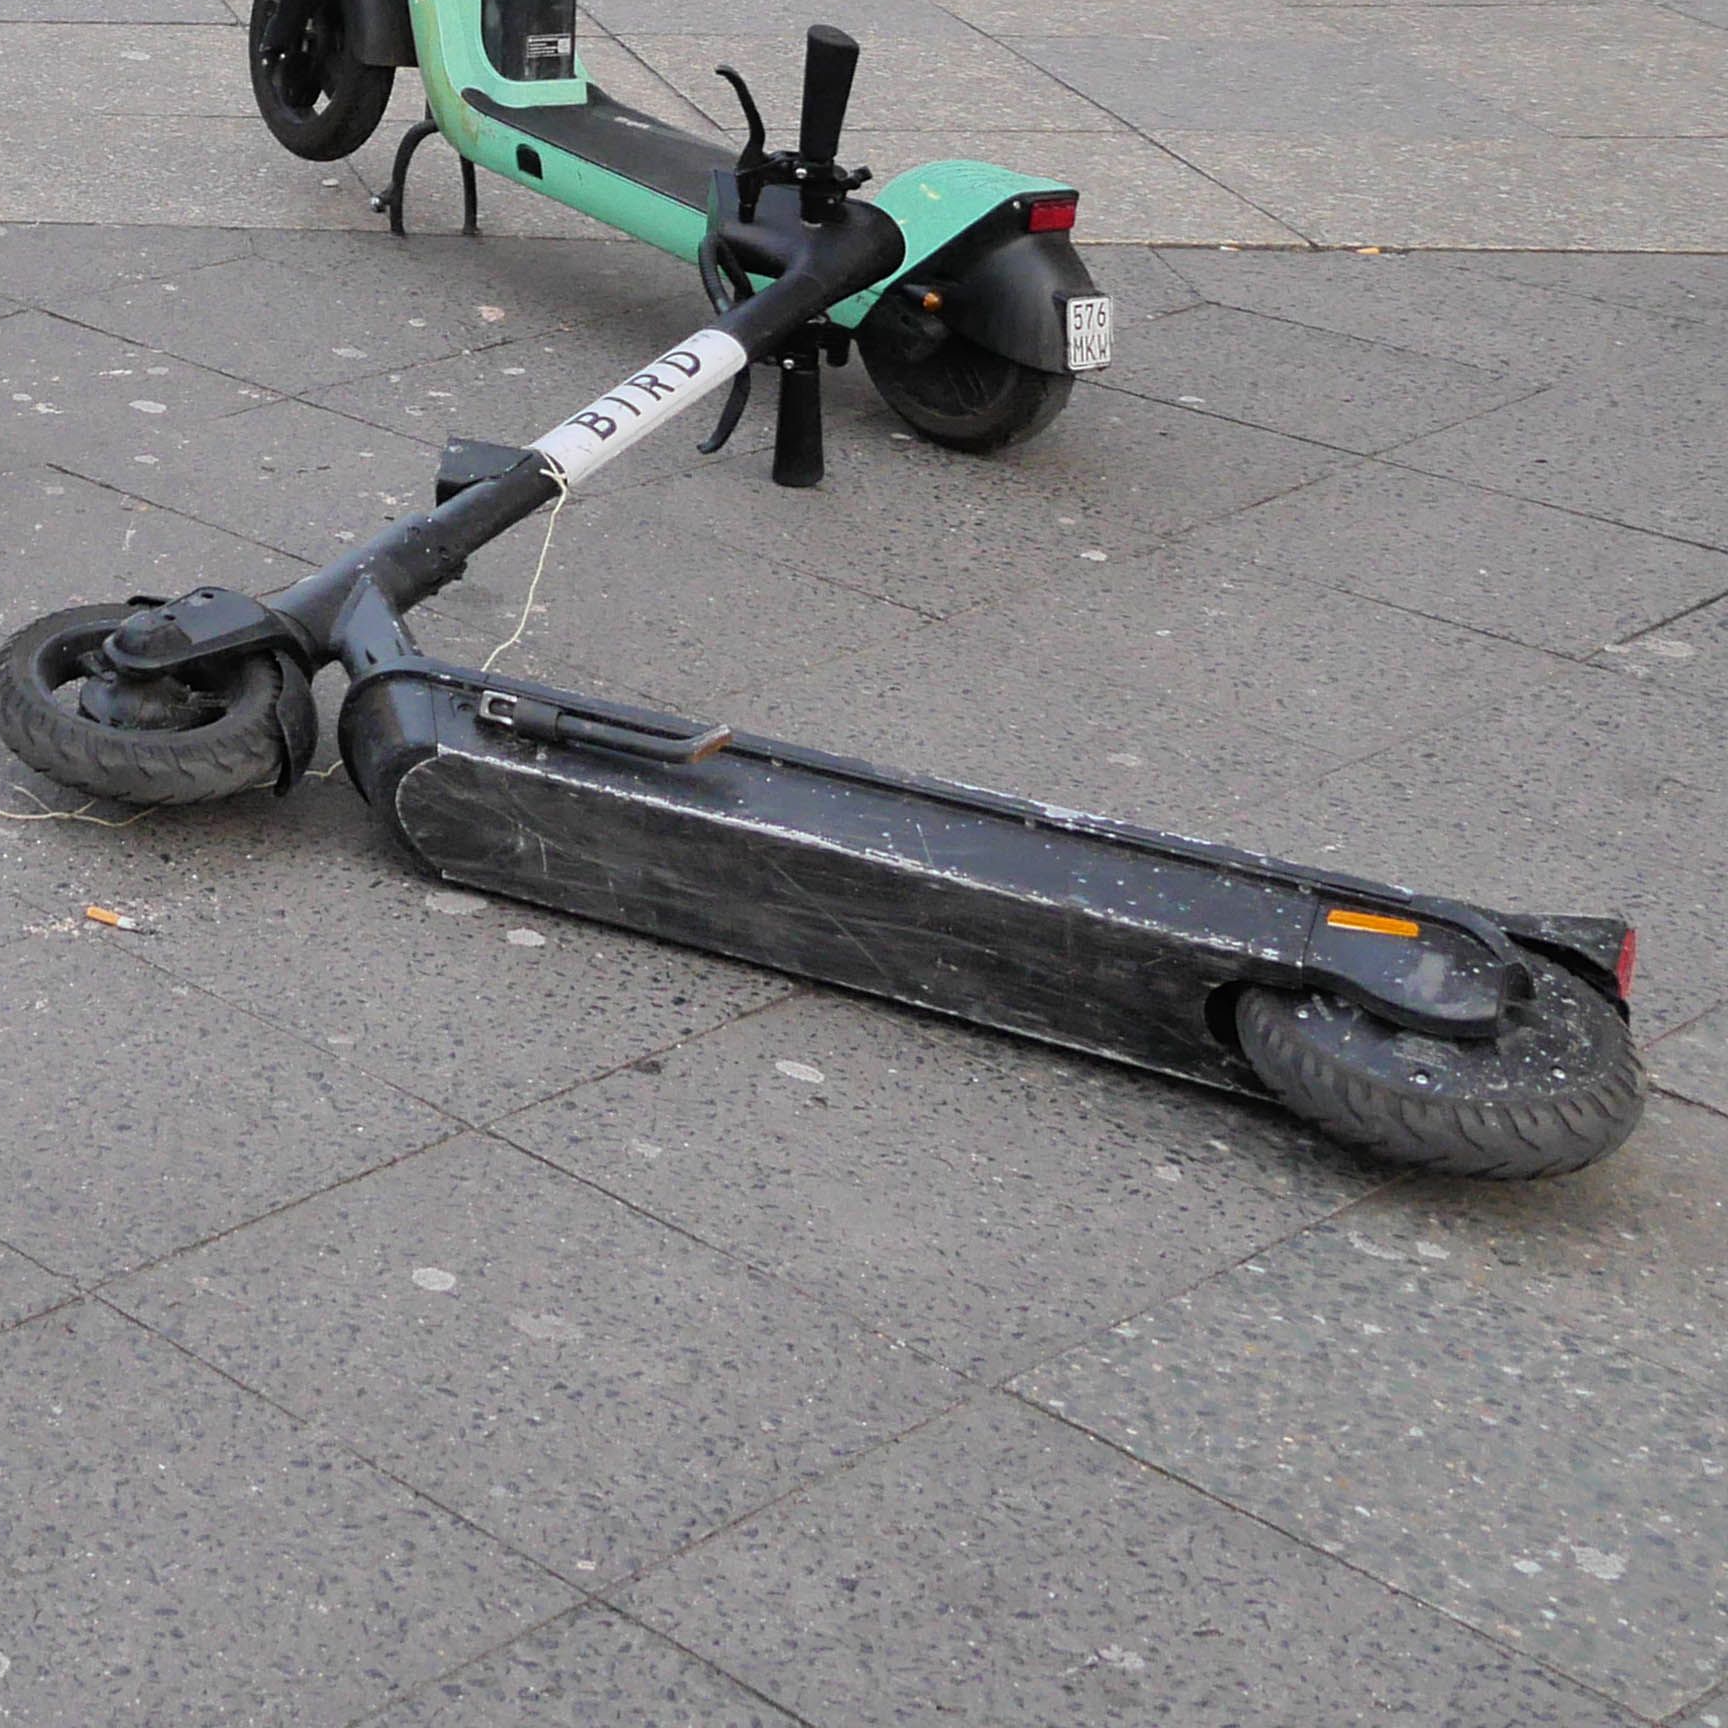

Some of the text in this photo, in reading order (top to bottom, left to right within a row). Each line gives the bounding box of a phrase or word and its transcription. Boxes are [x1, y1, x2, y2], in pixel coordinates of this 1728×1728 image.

[1072, 308, 1107, 332] 576
[1071, 334, 1109, 367] MKW
[567, 350, 702, 442] BIRD
